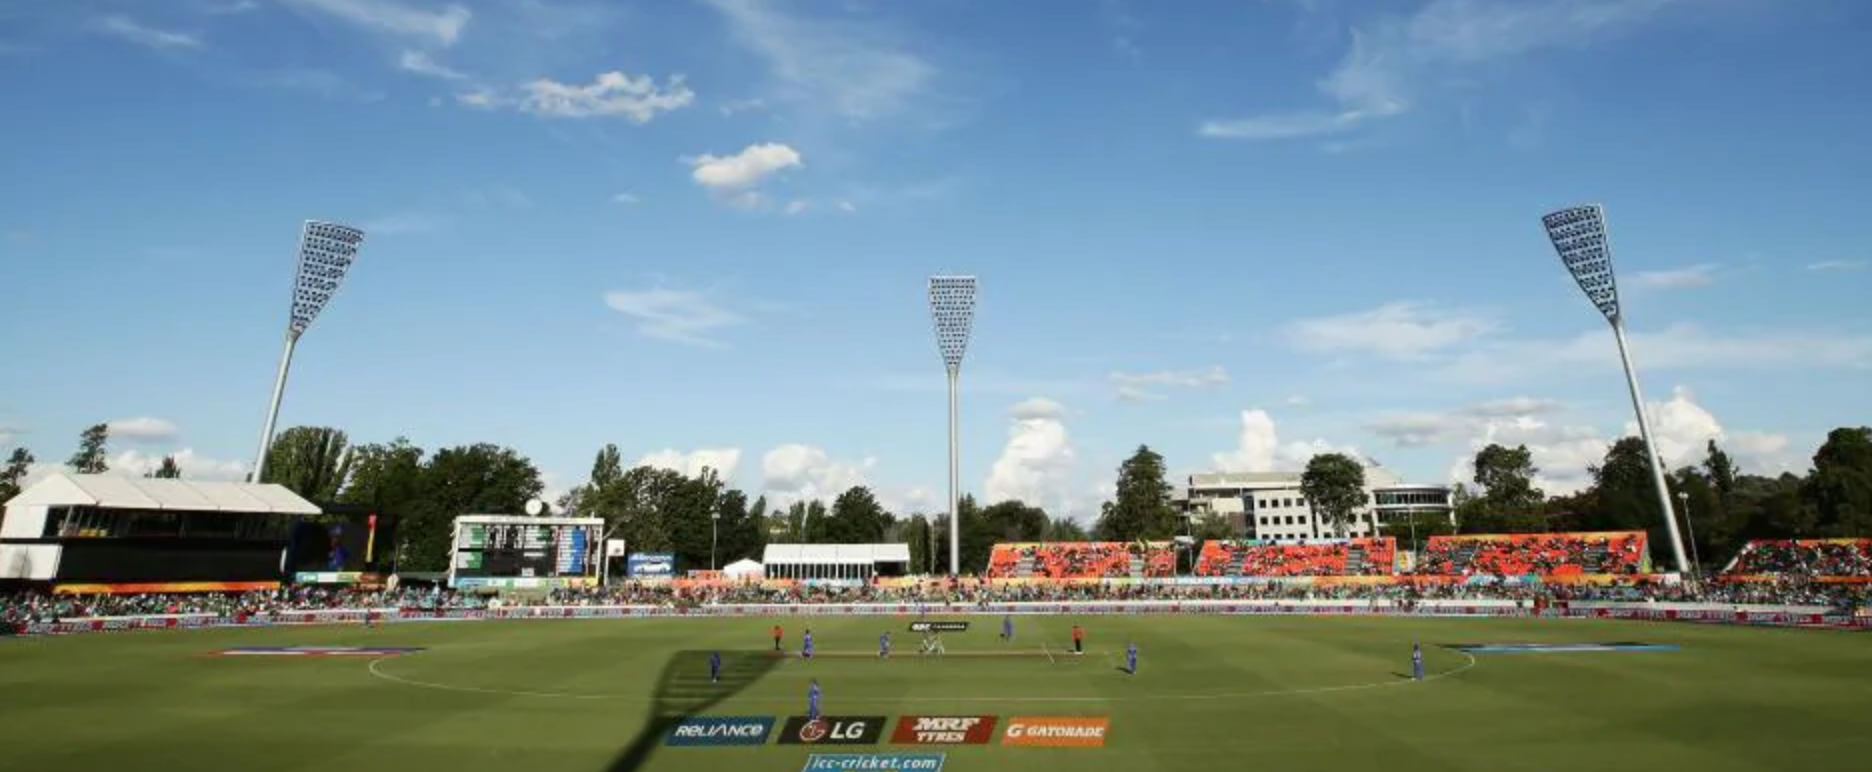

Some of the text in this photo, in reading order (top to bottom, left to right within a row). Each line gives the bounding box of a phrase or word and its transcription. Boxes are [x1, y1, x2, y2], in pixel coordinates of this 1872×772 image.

[829, 721, 866, 740] LG
[911, 716, 980, 731] MRF
[915, 731, 966, 743] TYRES
[1026, 725, 1105, 738] GATORADE
[811, 755, 937, 770] icc-cricket.com
